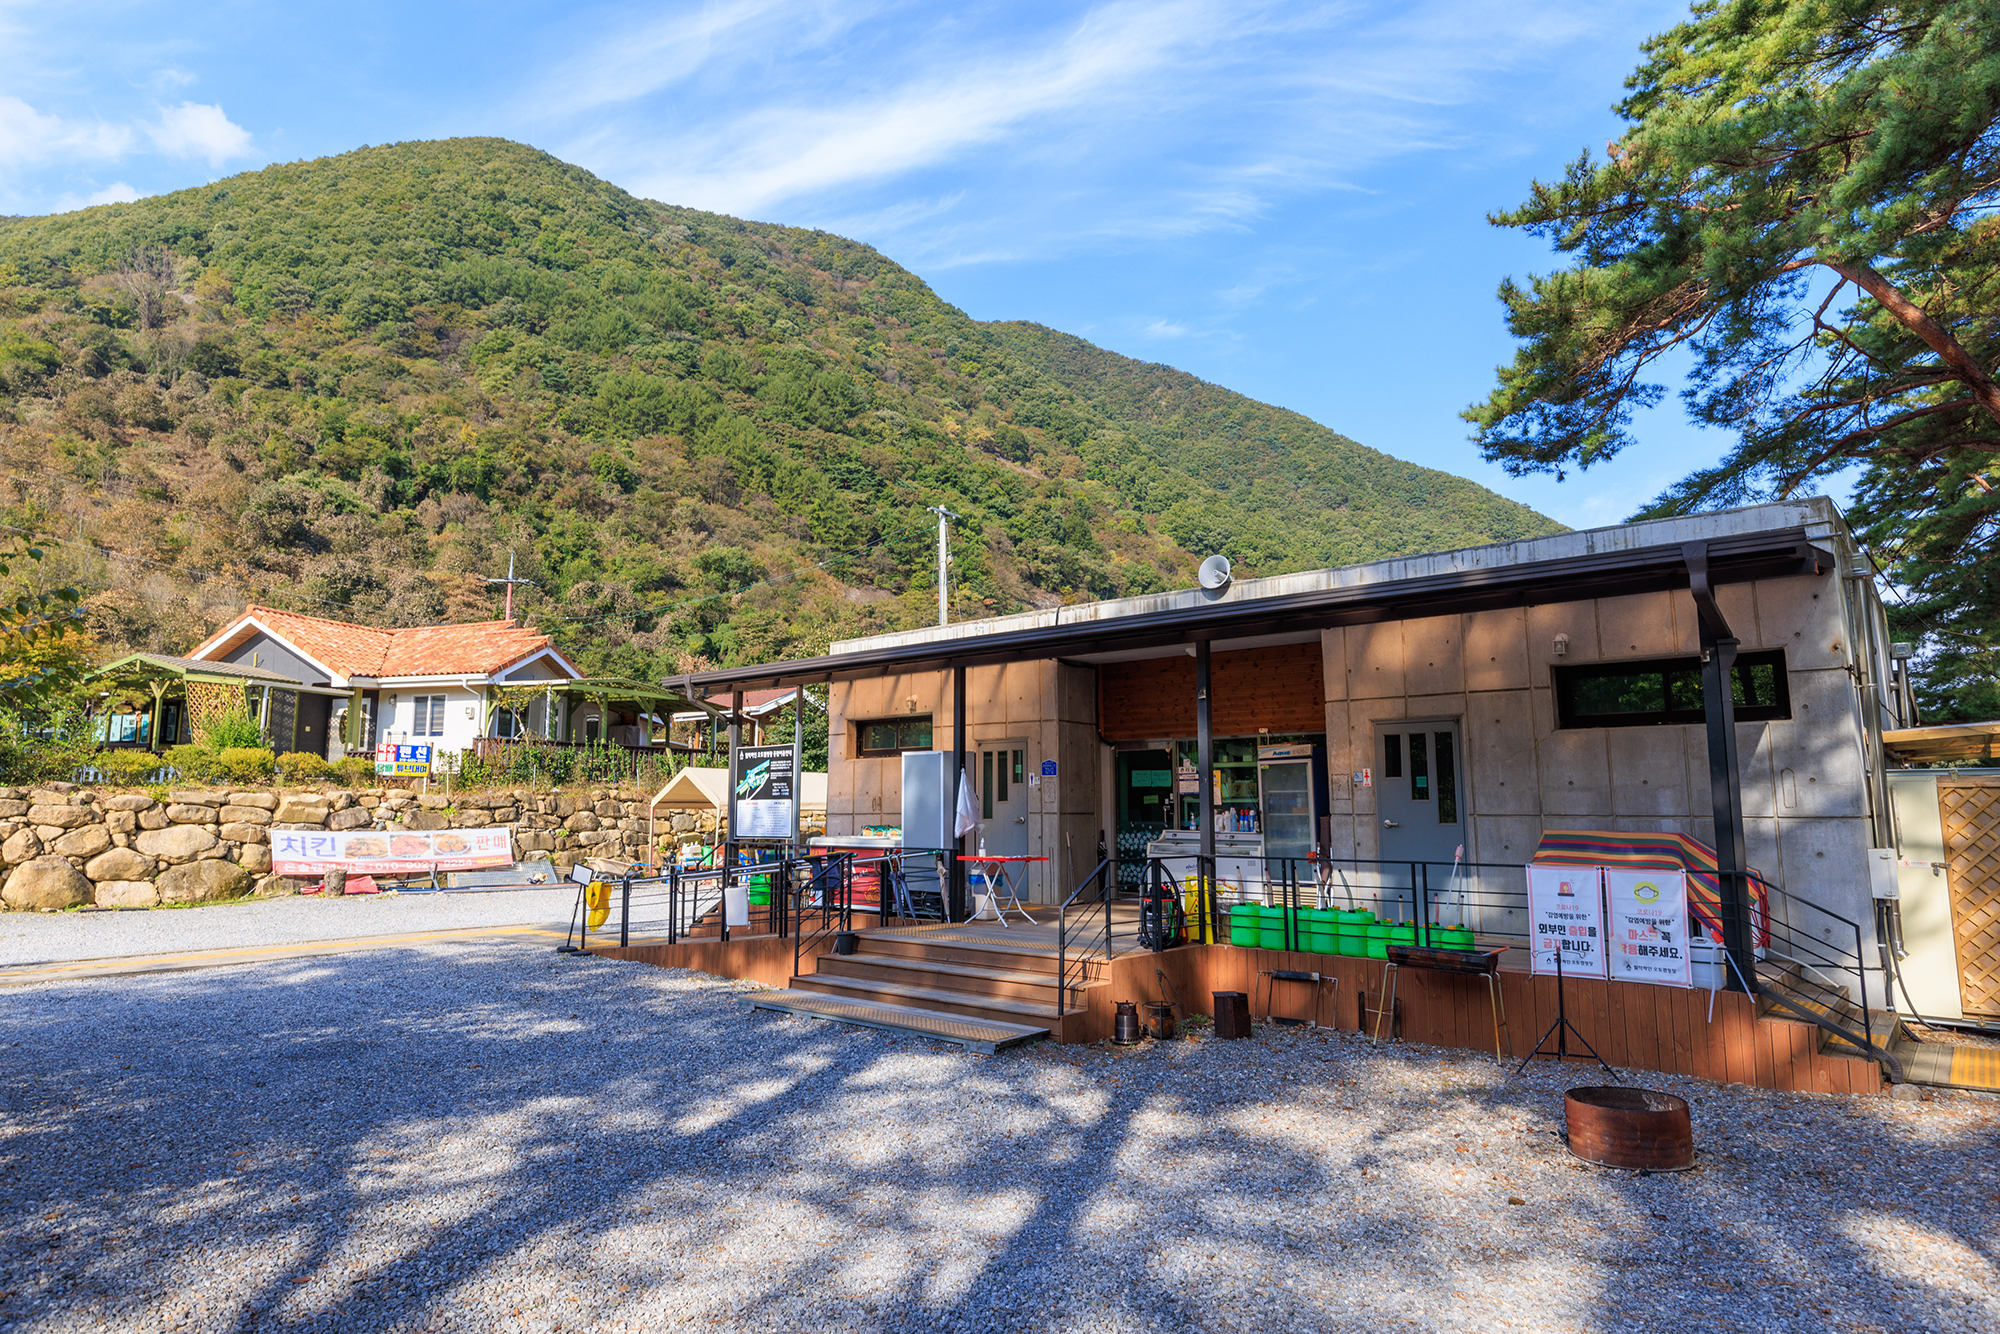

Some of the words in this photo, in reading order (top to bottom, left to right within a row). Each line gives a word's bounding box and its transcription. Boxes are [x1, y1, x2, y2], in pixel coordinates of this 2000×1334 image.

[396, 764, 427, 773] 튜브대여
[280, 835, 337, 857] 치킨
[475, 834, 507, 851] 판매
[1555, 903, 1579, 911] 코로나19
[1636, 908, 1663, 916] 코로나19
[1538, 923, 1566, 936] 외부인
[1568, 925, 1597, 938] 출입을
[1661, 931, 1671, 943] 꼭
[1543, 937, 1595, 952] 금지합니다.
